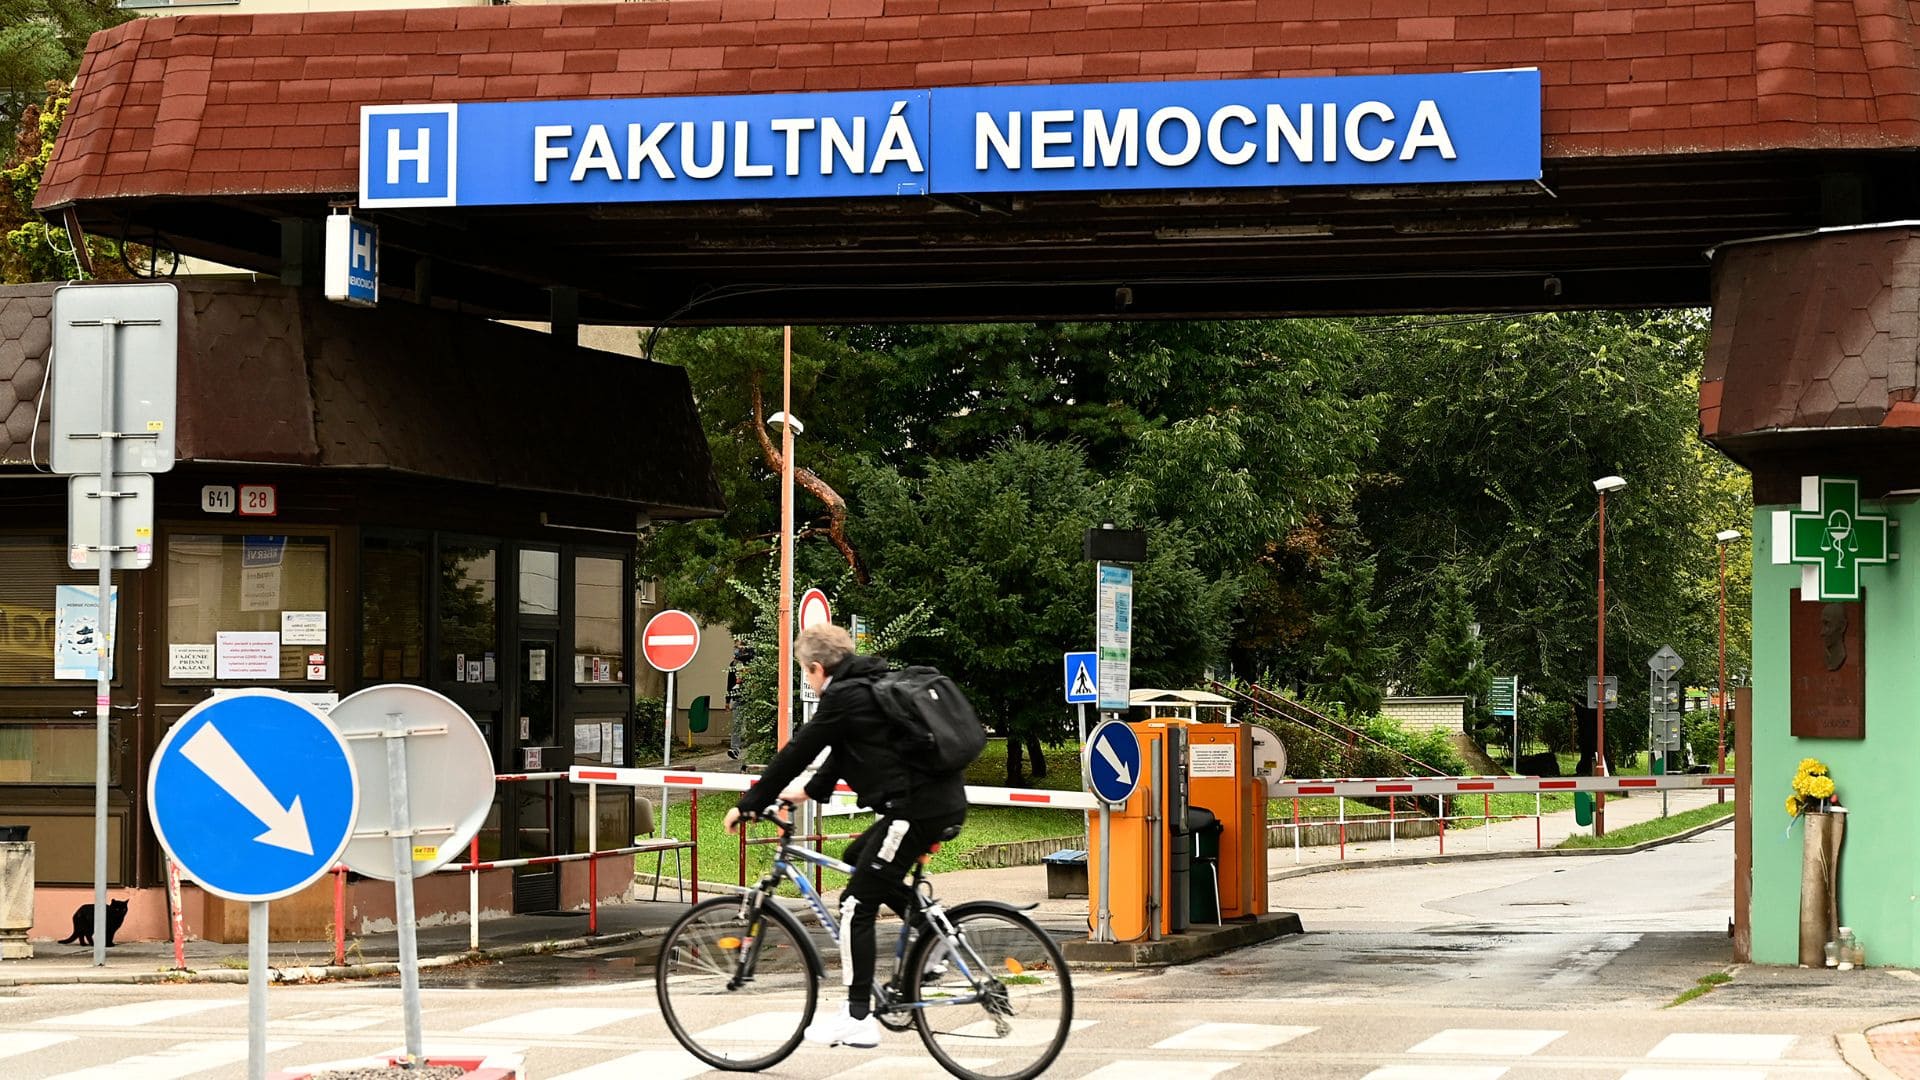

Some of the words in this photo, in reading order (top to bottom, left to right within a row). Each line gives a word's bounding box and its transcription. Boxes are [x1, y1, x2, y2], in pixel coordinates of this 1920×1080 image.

[386, 127, 430, 184] H
[533, 101, 924, 183] FAKULTNÁ
[975, 99, 1457, 170] NEMOCNICA
[352, 229, 371, 272] H
[208, 490, 229, 508] 641
[248, 491, 267, 508] 28
